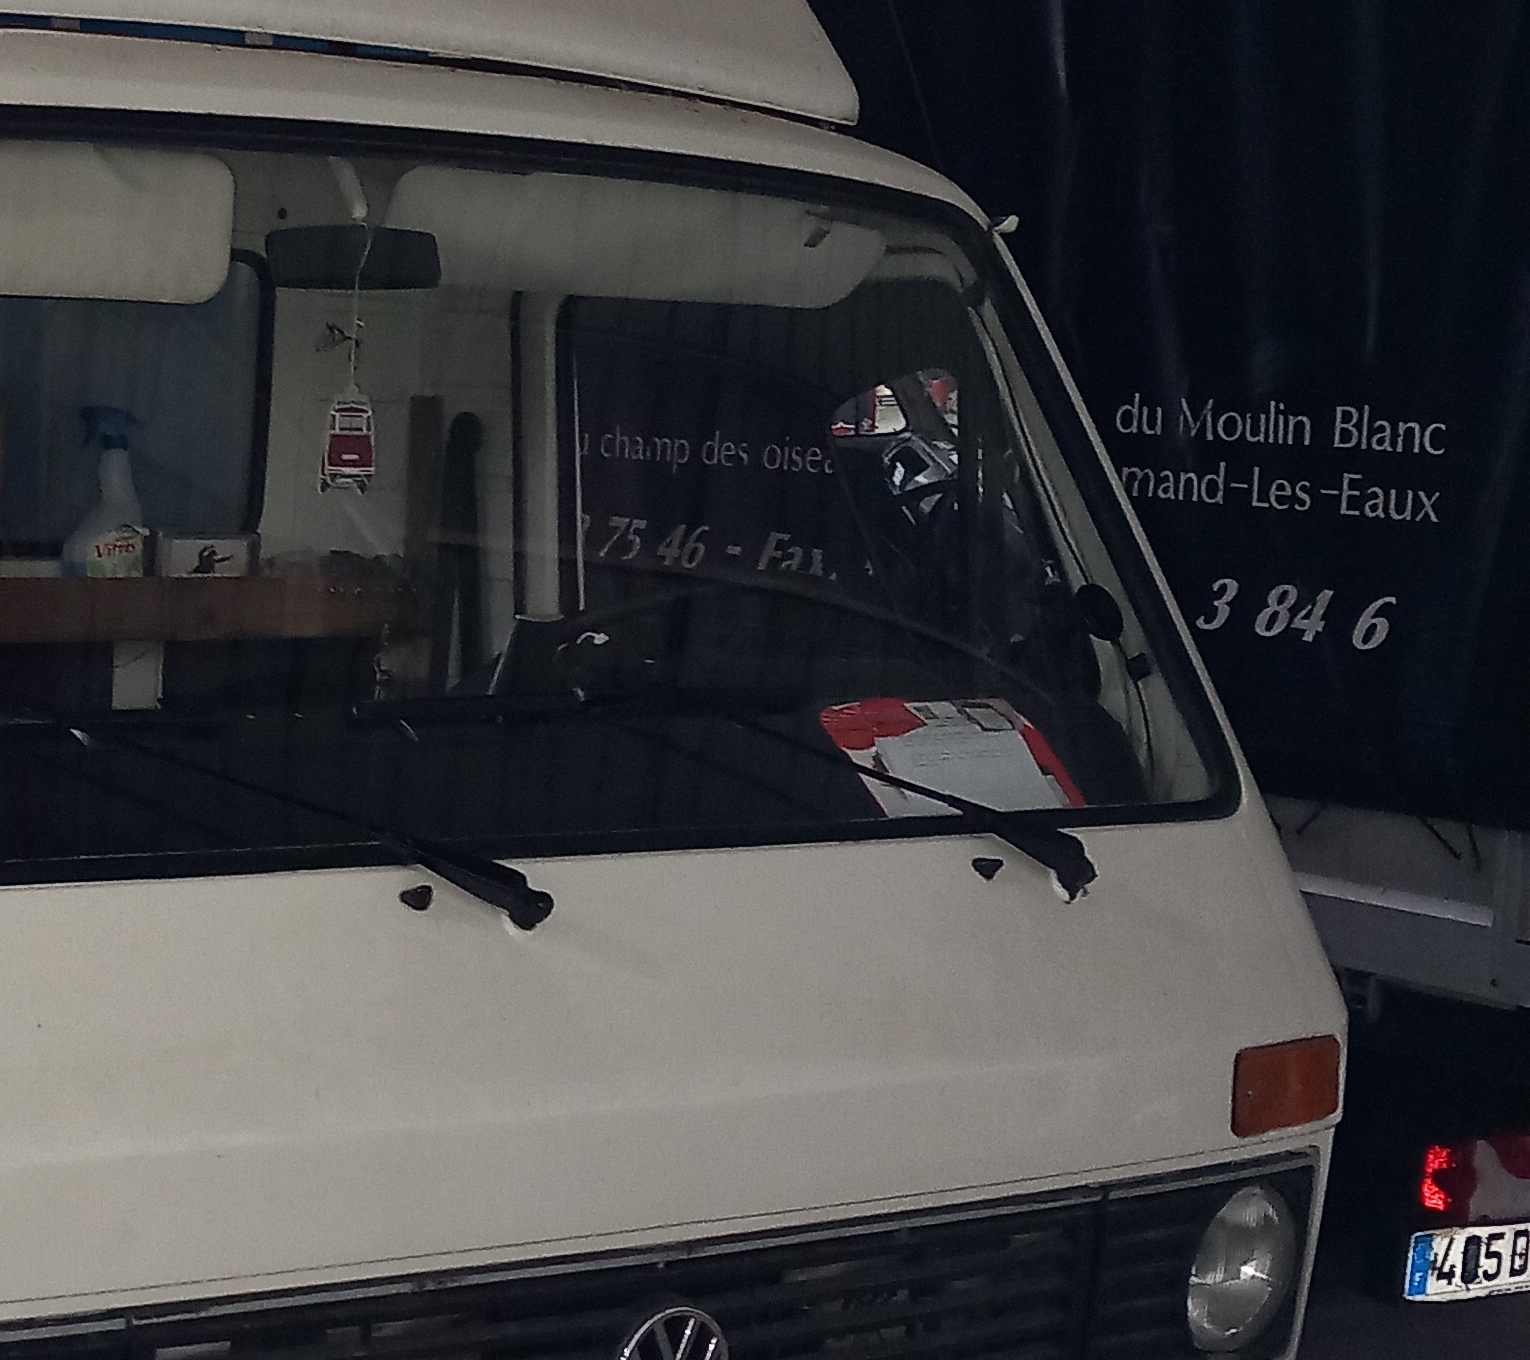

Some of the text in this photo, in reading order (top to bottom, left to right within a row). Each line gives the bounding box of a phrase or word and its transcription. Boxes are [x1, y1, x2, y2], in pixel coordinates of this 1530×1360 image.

[601, 426, 690, 474] champ
[701, 430, 748, 468] des
[1115, 392, 1447, 455] du Moulin Blanc
[599, 515, 648, 560] 75
[655, 523, 710, 570] 46
[1253, 583, 1334, 642] 84
